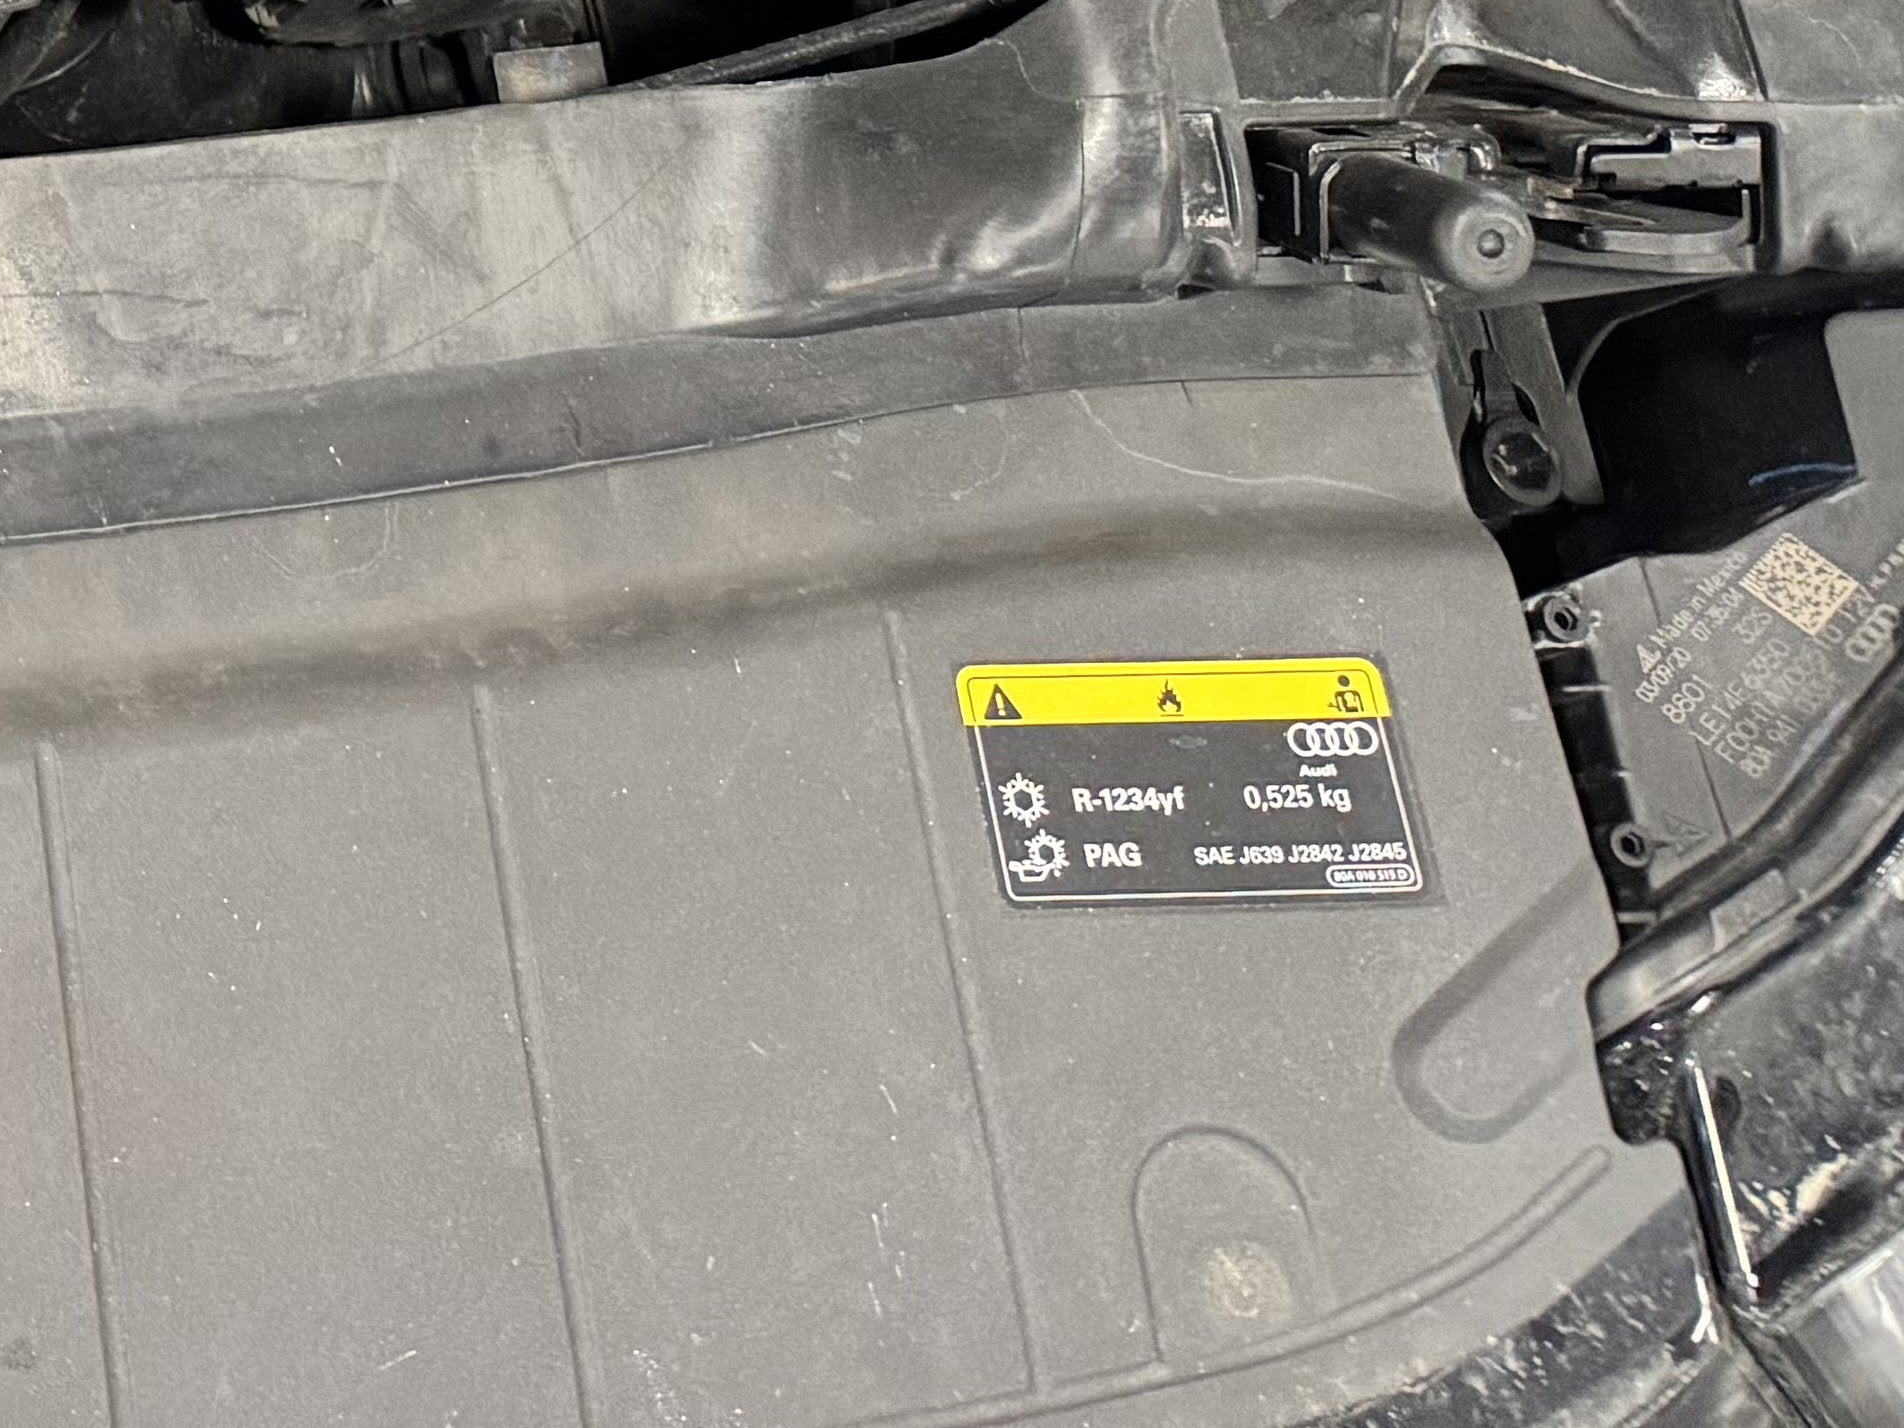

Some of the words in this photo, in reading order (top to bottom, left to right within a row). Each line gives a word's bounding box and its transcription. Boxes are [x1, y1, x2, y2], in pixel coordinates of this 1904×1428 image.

[1299, 763, 1338, 778] Audi
[1072, 787, 1186, 815] R-1234yf
[1243, 783, 1314, 812] 0,525
[1317, 785, 1352, 812] kg
[1083, 842, 1143, 868] PAG
[1194, 846, 1235, 865] SAE
[1238, 845, 1284, 865] J639
[1288, 843, 1345, 864] J2842
[1347, 842, 1407, 862] J2845
